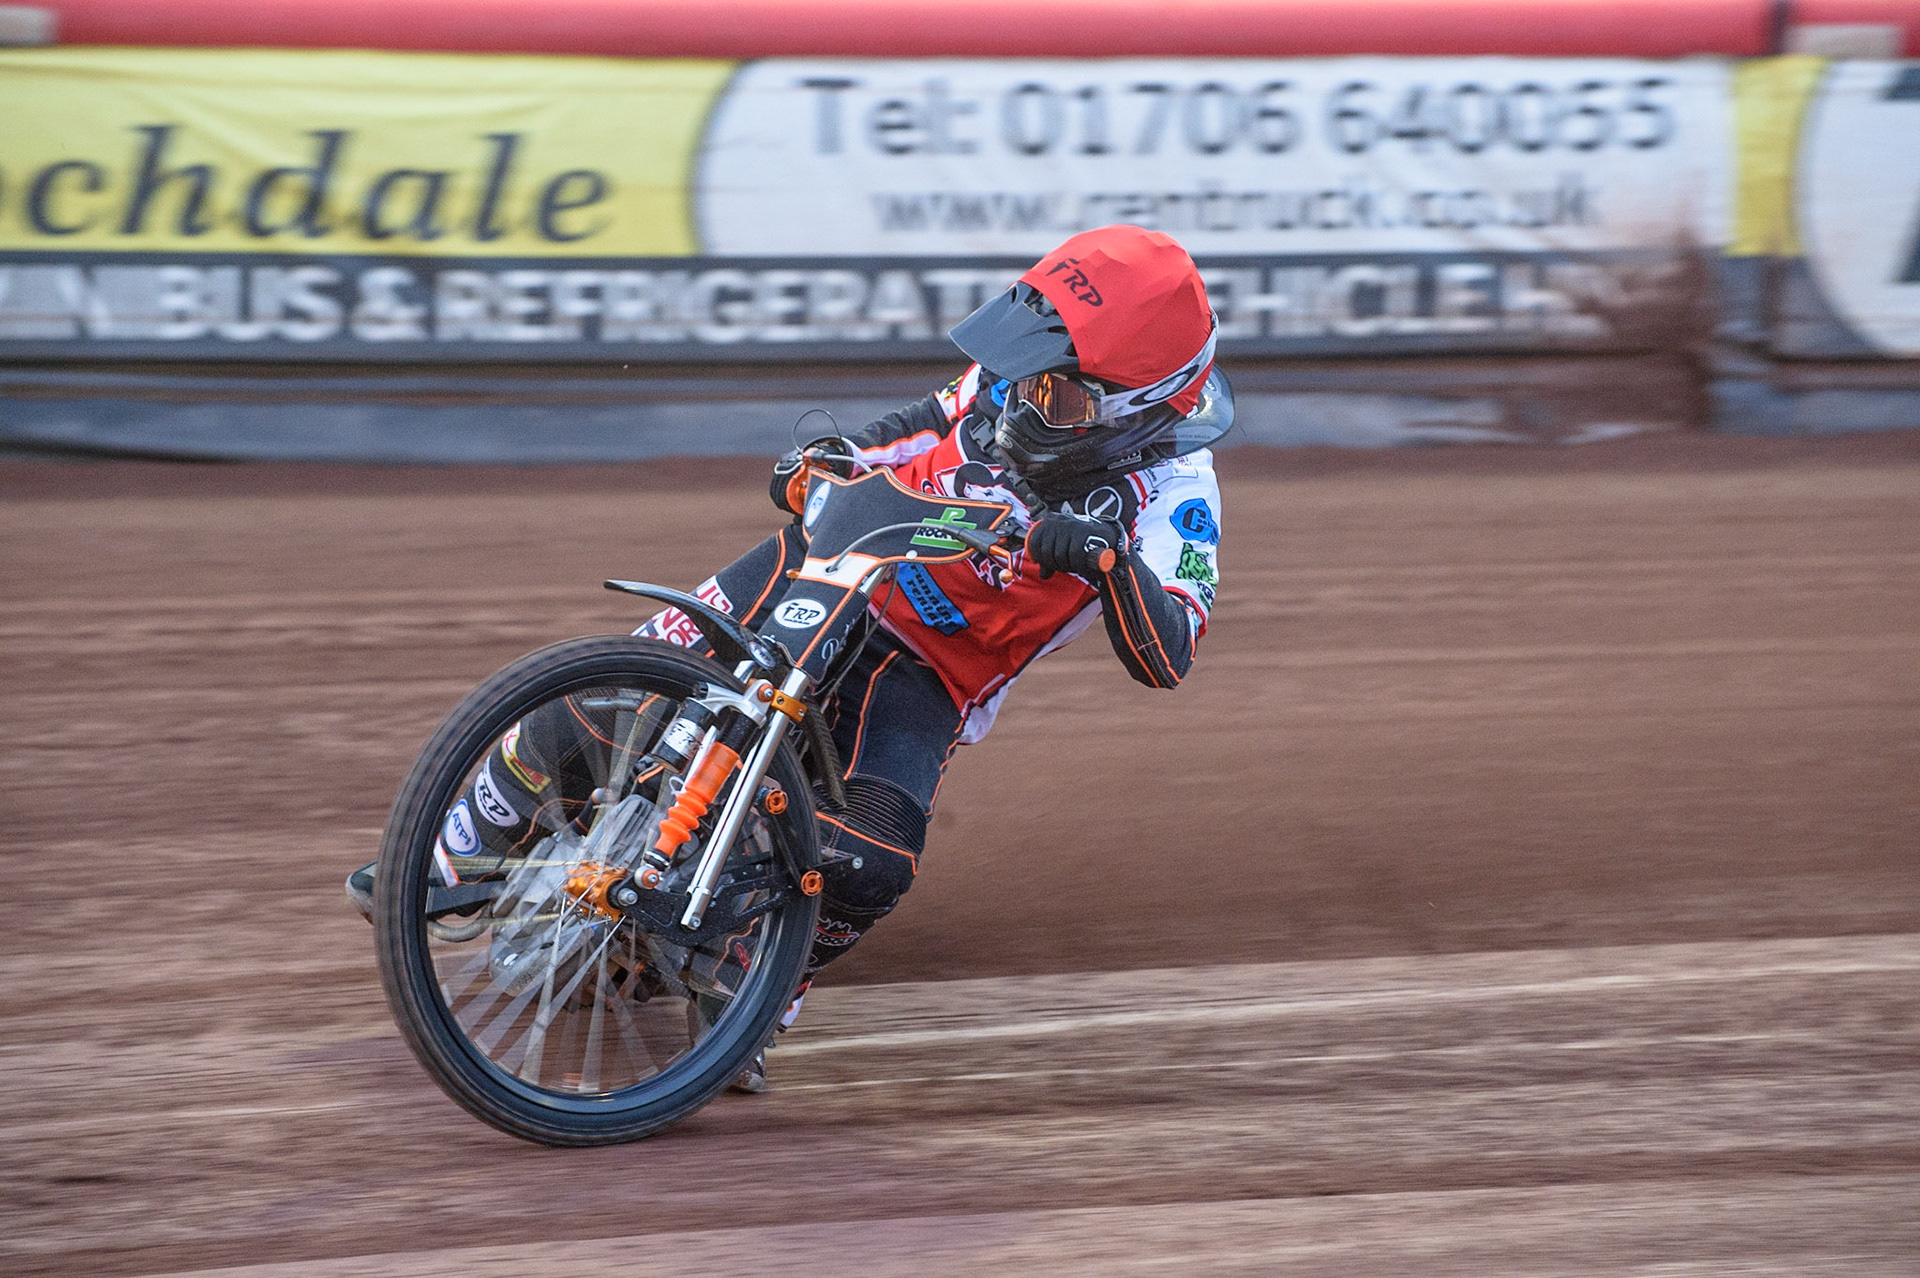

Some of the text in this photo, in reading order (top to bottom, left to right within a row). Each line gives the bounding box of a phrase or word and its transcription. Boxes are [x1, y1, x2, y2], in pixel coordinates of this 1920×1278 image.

[998, 80, 1302, 157] 01706
[0, 123, 618, 244] chdale
[1045, 256, 1104, 309] FRP
[782, 602, 821, 621] FRP
[478, 777, 511, 818] RP
